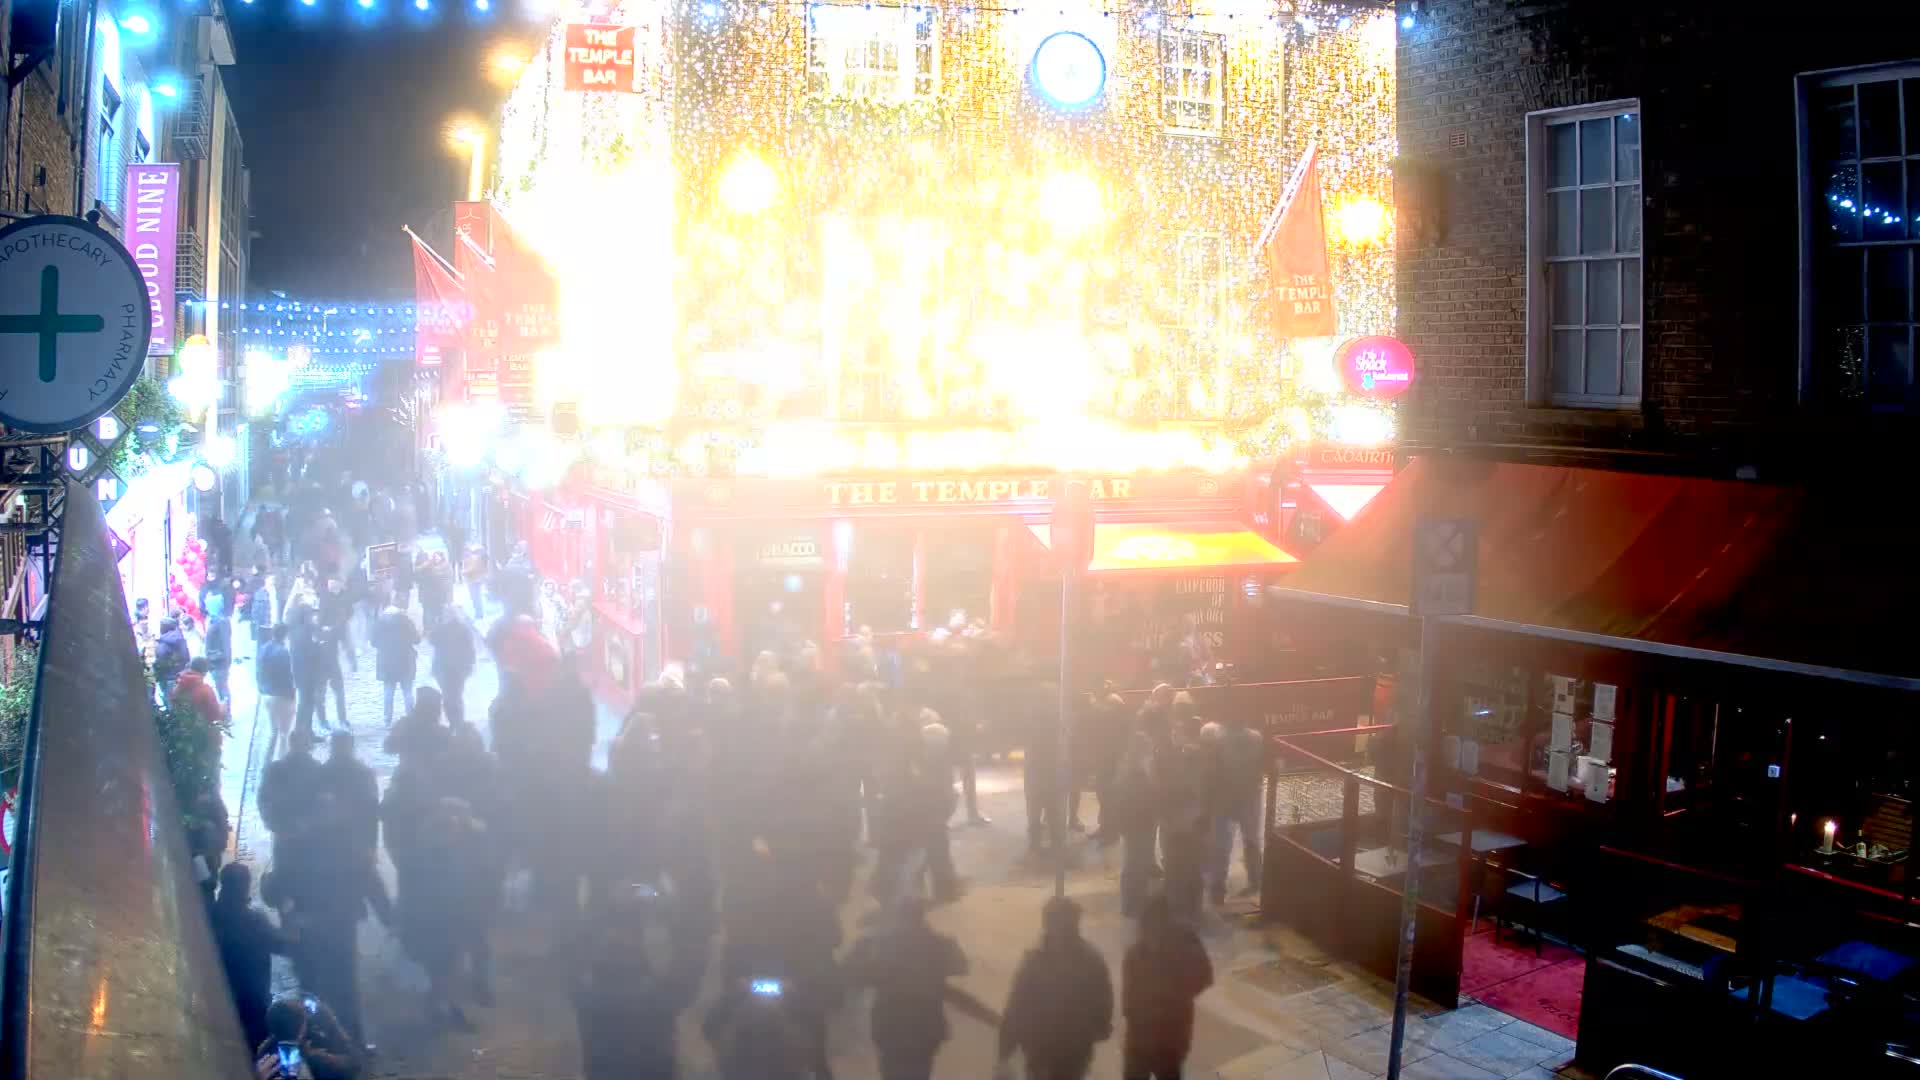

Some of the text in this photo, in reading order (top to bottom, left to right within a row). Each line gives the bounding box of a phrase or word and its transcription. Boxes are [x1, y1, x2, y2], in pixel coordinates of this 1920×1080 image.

[583, 29, 617, 46] THE
[567, 47, 633, 65] TEMPLE
[583, 69, 617, 85] BAR
[135, 171, 169, 233] NINE
[1293, 274, 1316, 286] THE
[1293, 301, 1321, 314] BAR
[88, 303, 137, 401] PHARMACY
[824, 479, 1131, 503] THE TEMPLE AR
